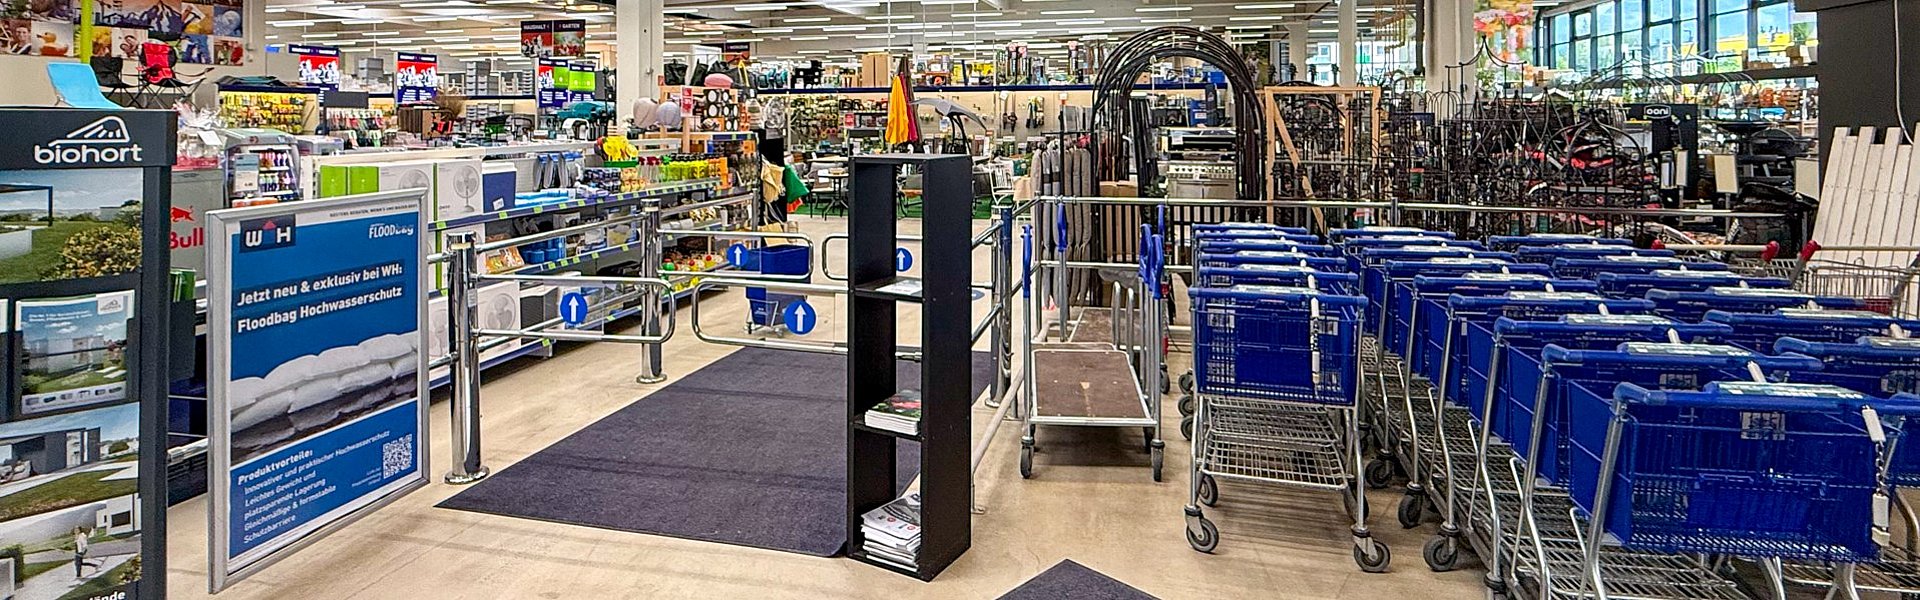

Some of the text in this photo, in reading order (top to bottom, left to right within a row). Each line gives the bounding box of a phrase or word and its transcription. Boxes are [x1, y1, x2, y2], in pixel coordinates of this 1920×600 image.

[1646, 107, 1669, 115] ooni
[34, 143, 143, 164] biohort
[169, 227, 204, 249] Bull
[237, 262, 403, 307] Jetzt neu & exklusiv bei WH:
[237, 286, 403, 333] Floodbag Hochwasserschutz
[237, 449, 314, 486] Produktvorteile:
[244, 430, 390, 495] Innovativer und praktischer Hochwasserschutz
[244, 478, 326, 521] platzsparende Lagerung
[245, 469, 317, 507] Leichtes Gewicht und
[292, 501, 298, 509] &
[299, 485, 337, 506] formstabile
[243, 514, 296, 544] Schutzbarriere
